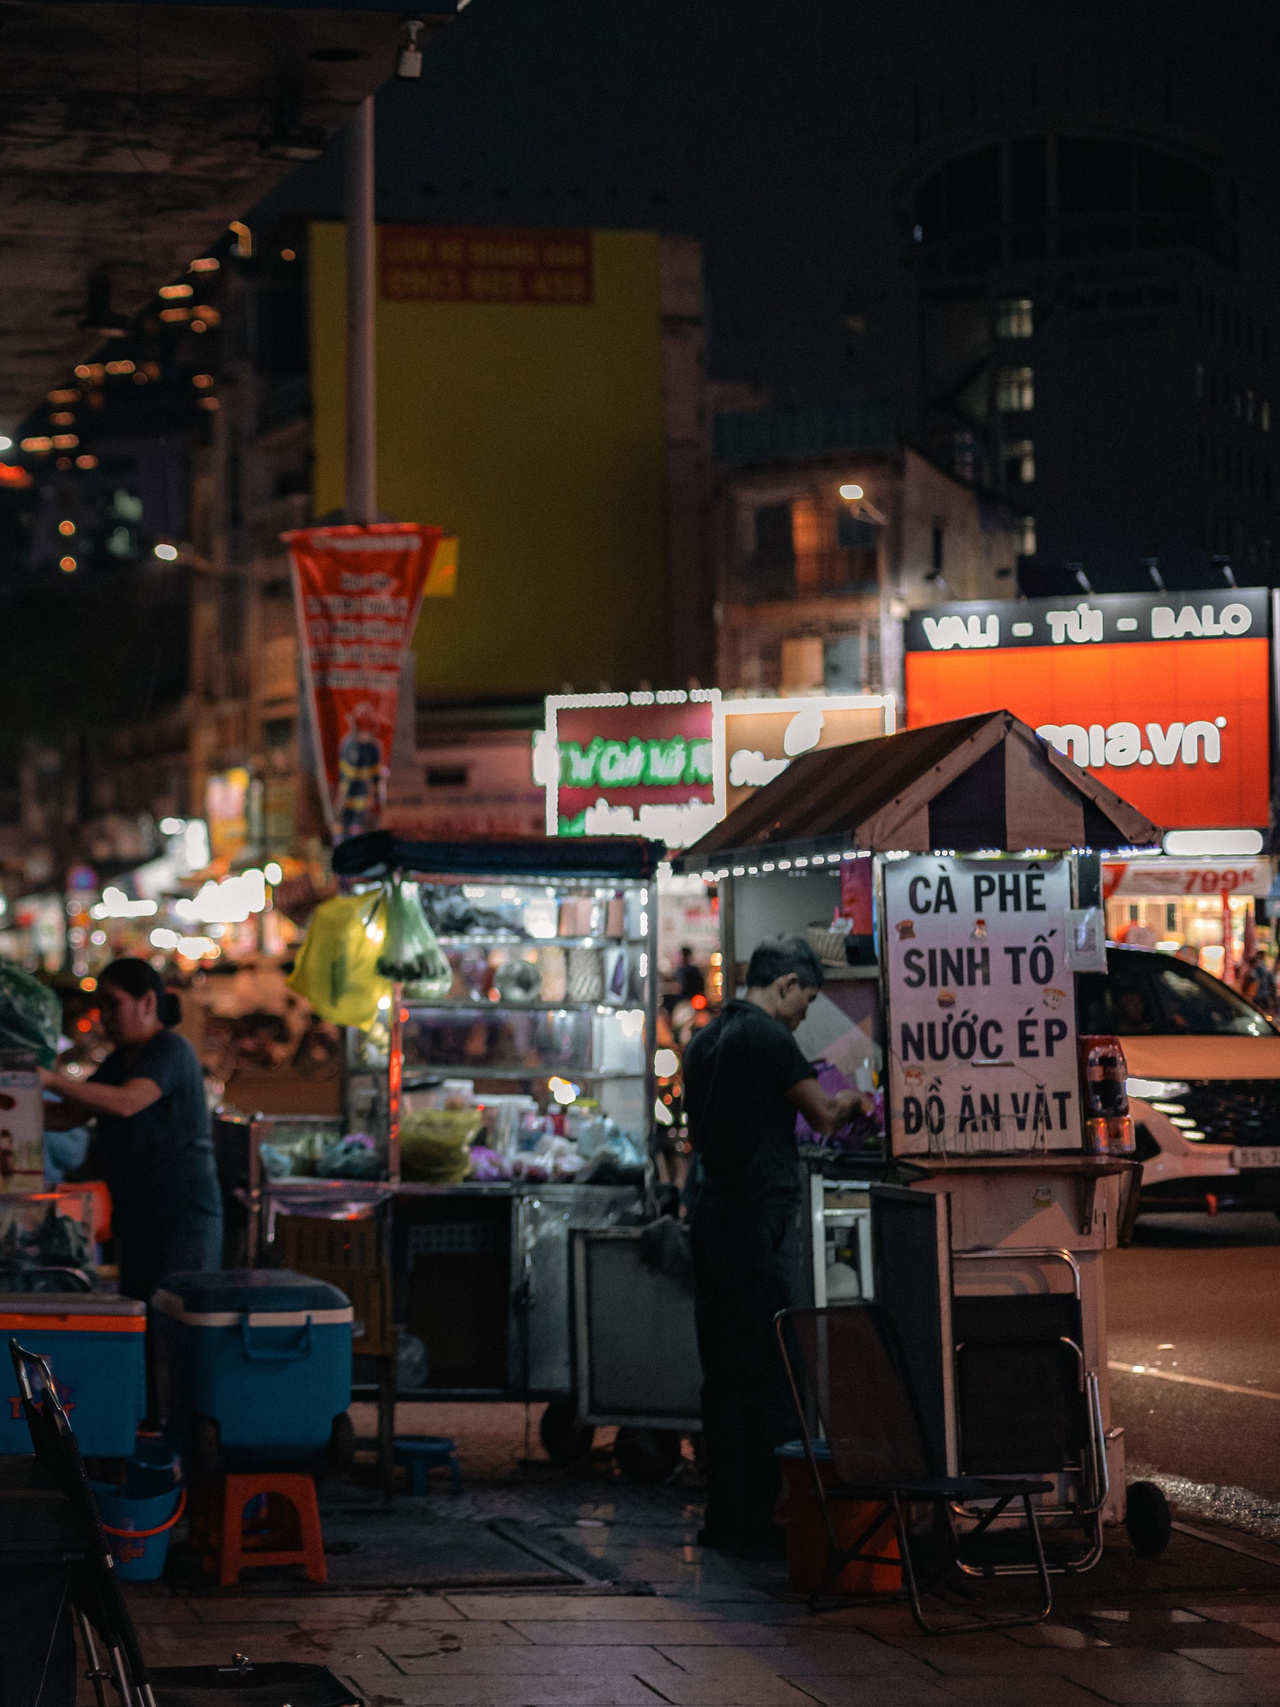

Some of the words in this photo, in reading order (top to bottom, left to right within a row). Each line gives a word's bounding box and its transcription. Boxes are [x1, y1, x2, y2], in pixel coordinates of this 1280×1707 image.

[922, 614, 999, 650] VALI
[1151, 603, 1252, 638] BALO
[908, 865, 957, 914] CÀ
[973, 863, 1046, 912] PHÊ
[903, 947, 991, 988] SINH
[1004, 929, 1057, 985] TỐ
[900, 1009, 1003, 1061] NƯỚC
[1017, 1008, 1067, 1058] ÉP
[902, 1076, 945, 1134] ĐỒ
[958, 1085, 1001, 1133] ĂN
